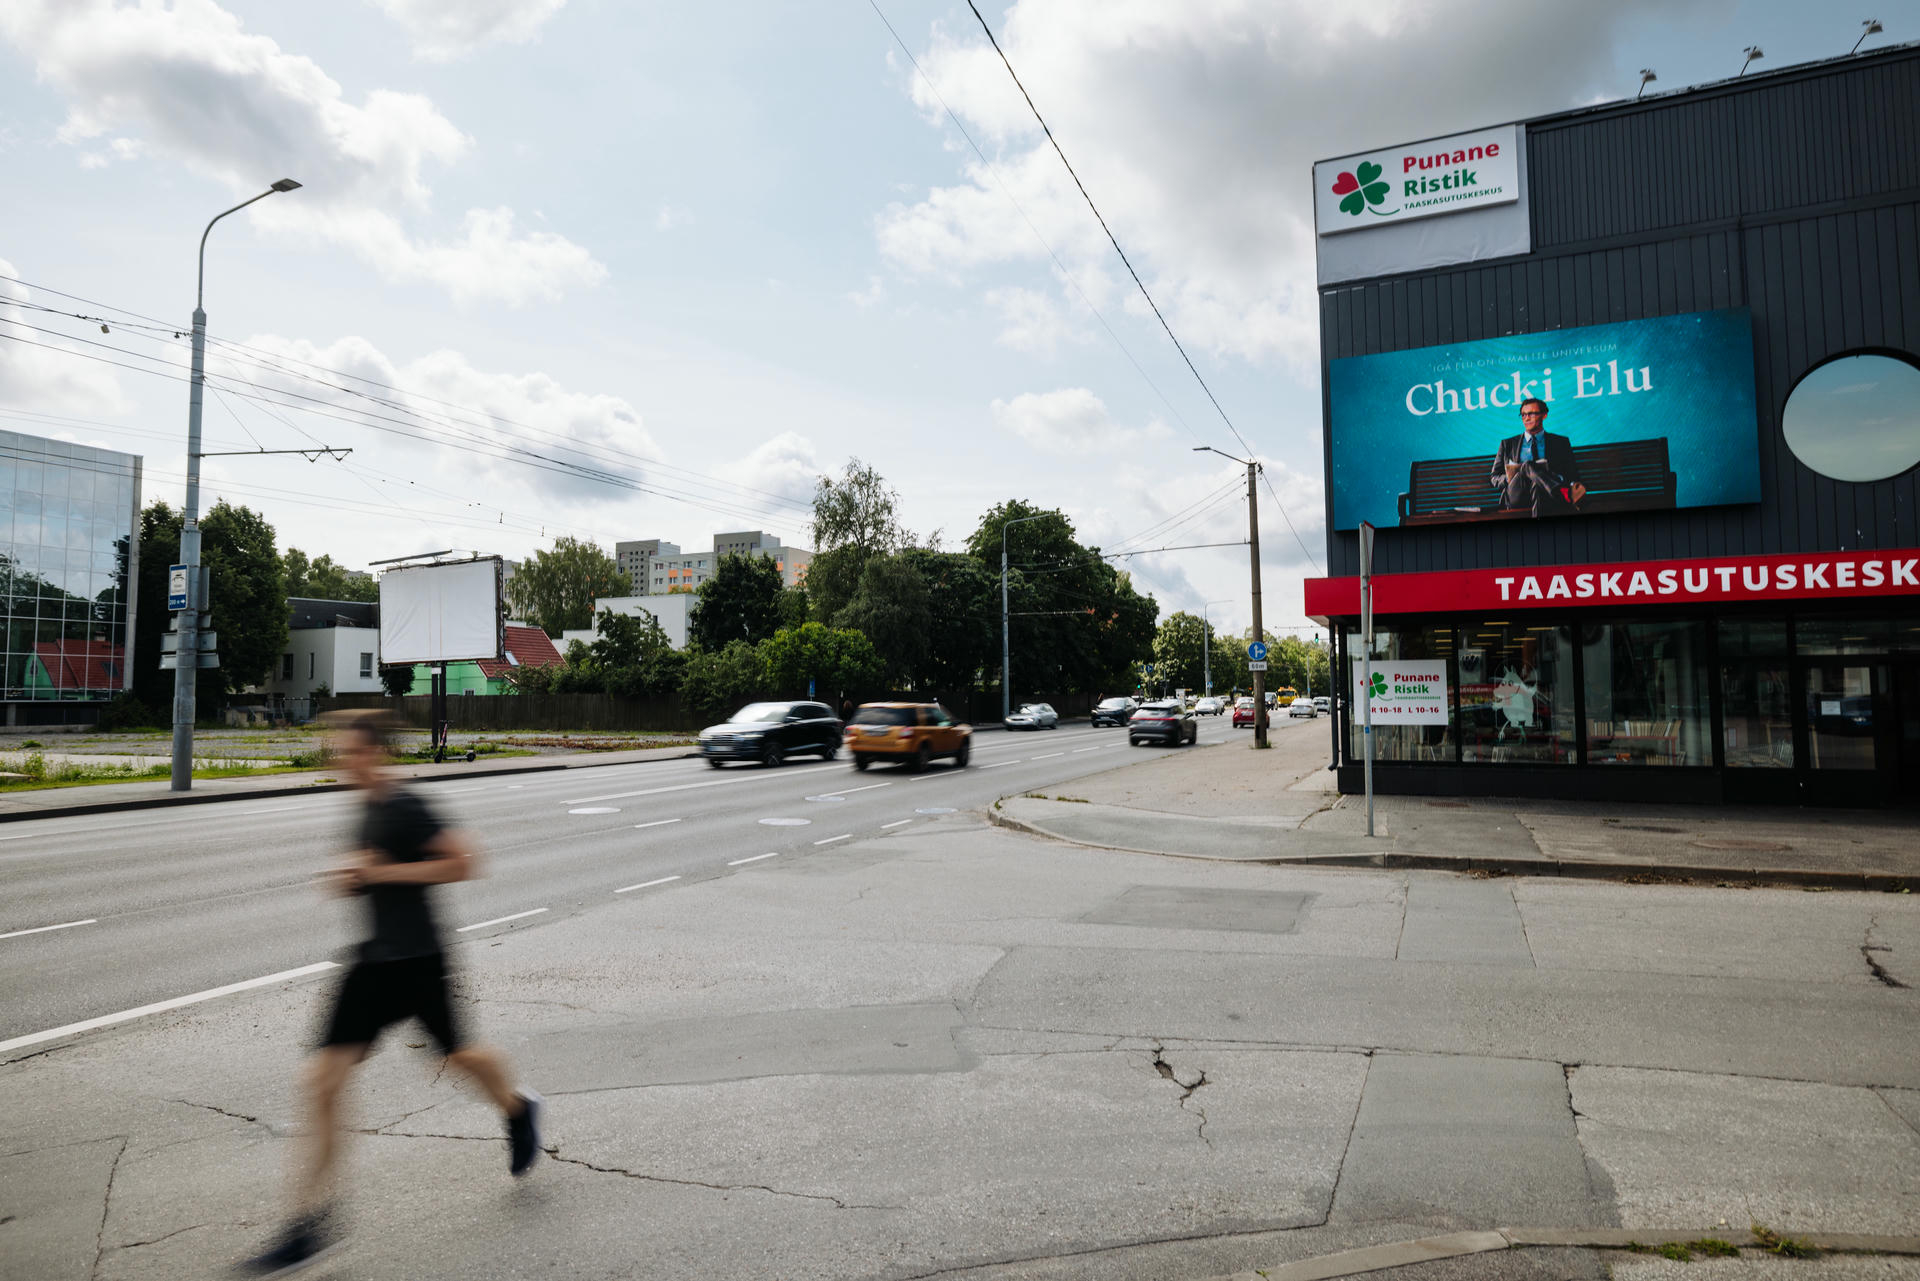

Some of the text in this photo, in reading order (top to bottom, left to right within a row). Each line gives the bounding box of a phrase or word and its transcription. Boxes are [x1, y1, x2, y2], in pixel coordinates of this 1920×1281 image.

[1403, 144, 1499, 173] Punane
[1404, 168, 1477, 197] Ristik
[1404, 186, 1502, 210] TAASKASUTUSKESKUS
[1552, 343, 1617, 358] UNIVERSUM
[1405, 359, 1654, 417] Chucki Elu
[1495, 558, 1920, 600] TAASKASUTUSKESK
[1394, 673, 1440, 682] Punane
[1394, 684, 1429, 694] Ristik
